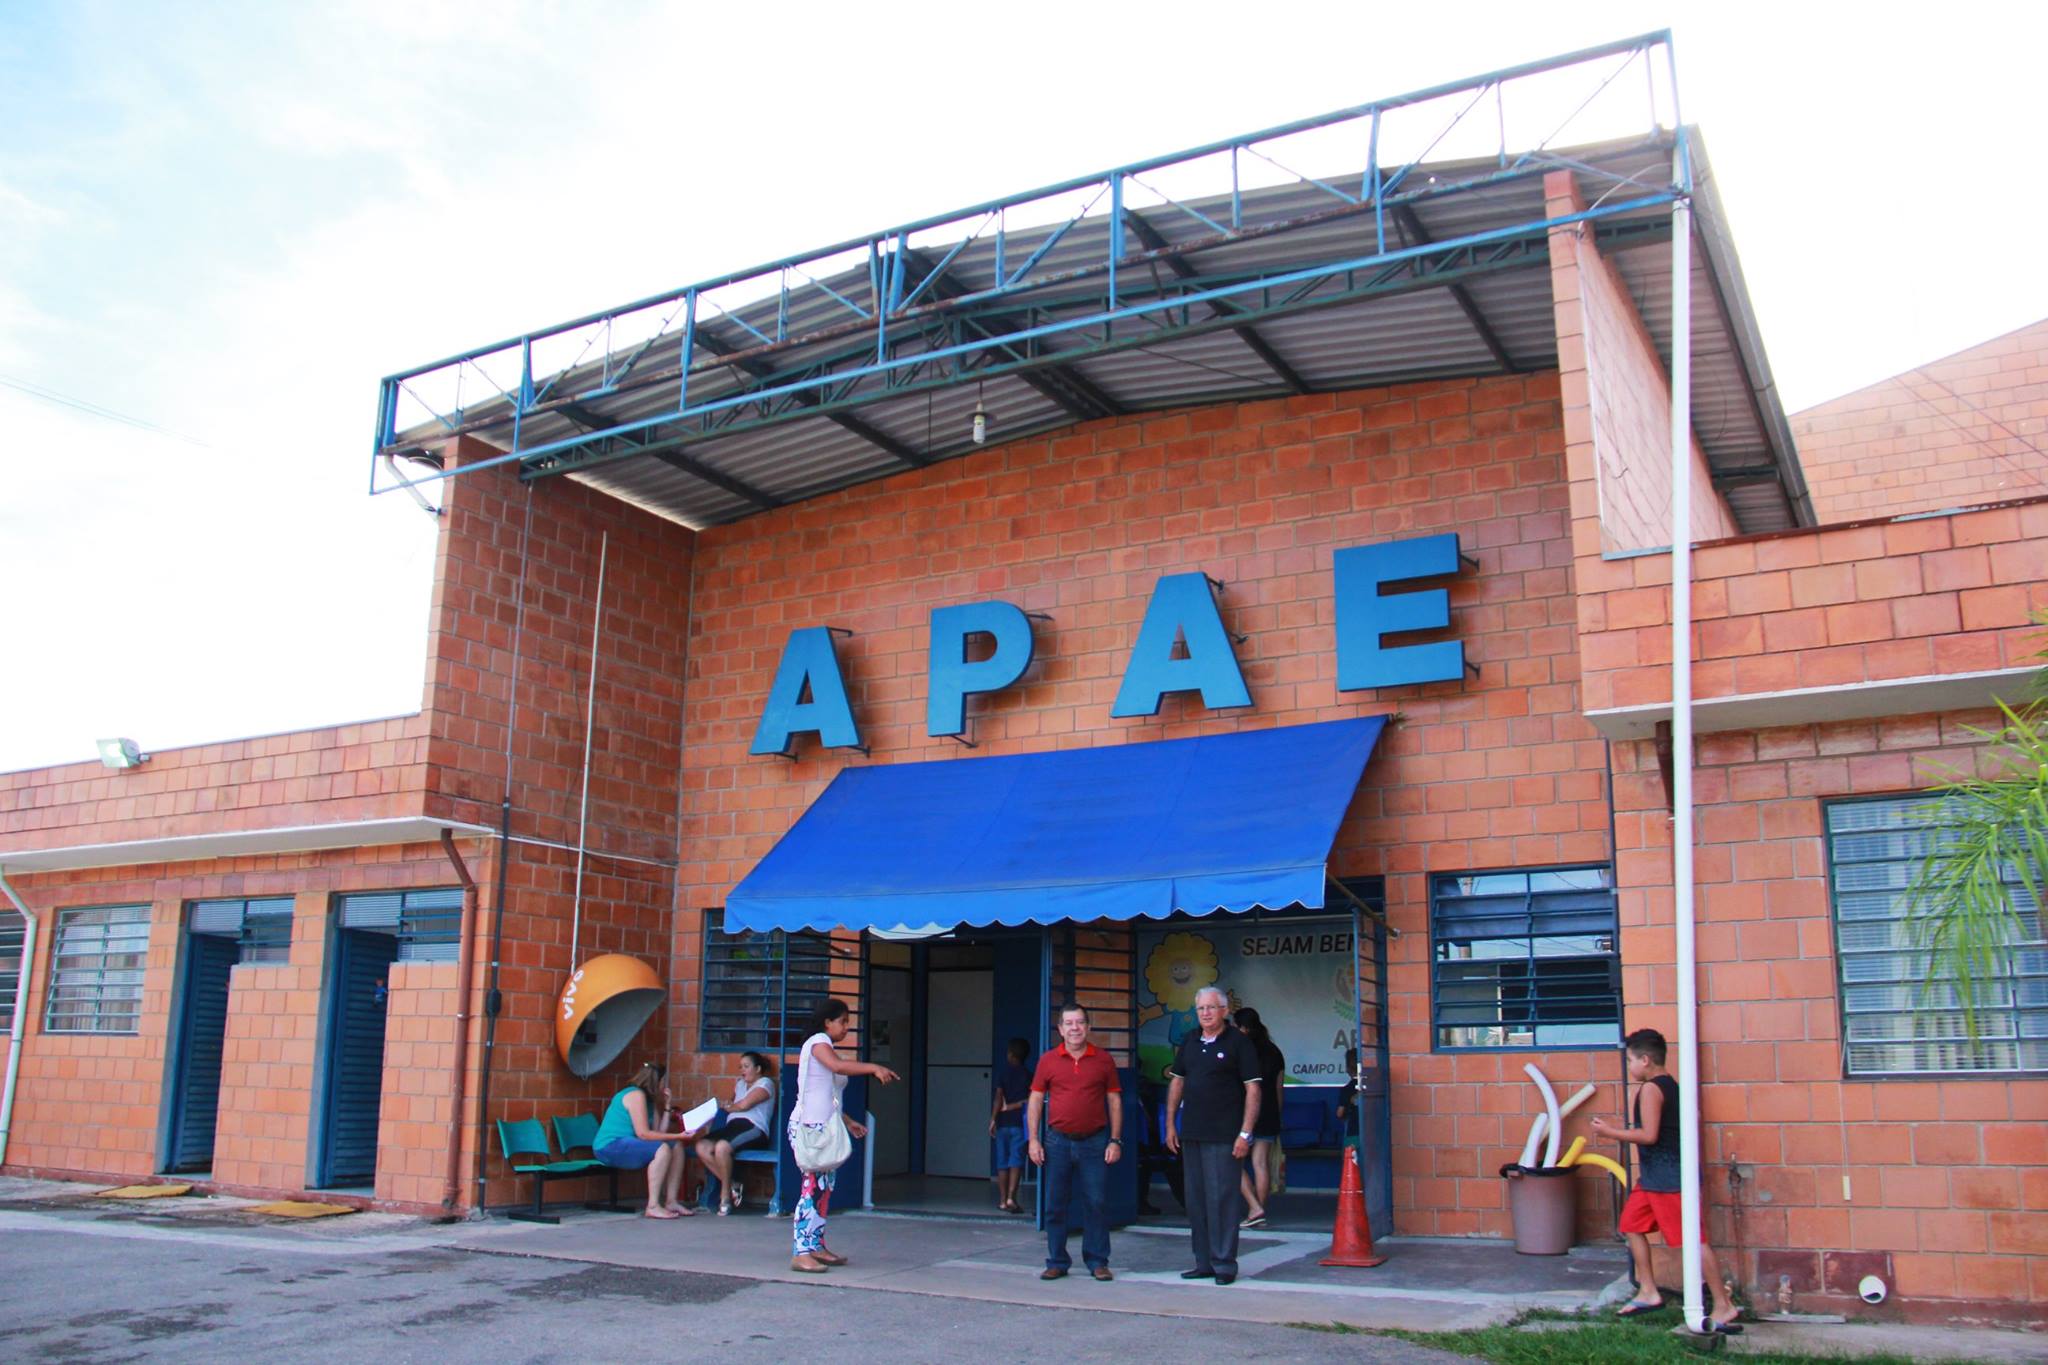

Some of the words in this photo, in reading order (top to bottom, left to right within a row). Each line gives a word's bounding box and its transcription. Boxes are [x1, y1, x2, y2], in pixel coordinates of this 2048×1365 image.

[749, 533, 1465, 755] APAE
[1243, 936, 1313, 955] SEJAM
[562, 970, 584, 1020] vivo
[1292, 1063, 1335, 1074] CAMPO
